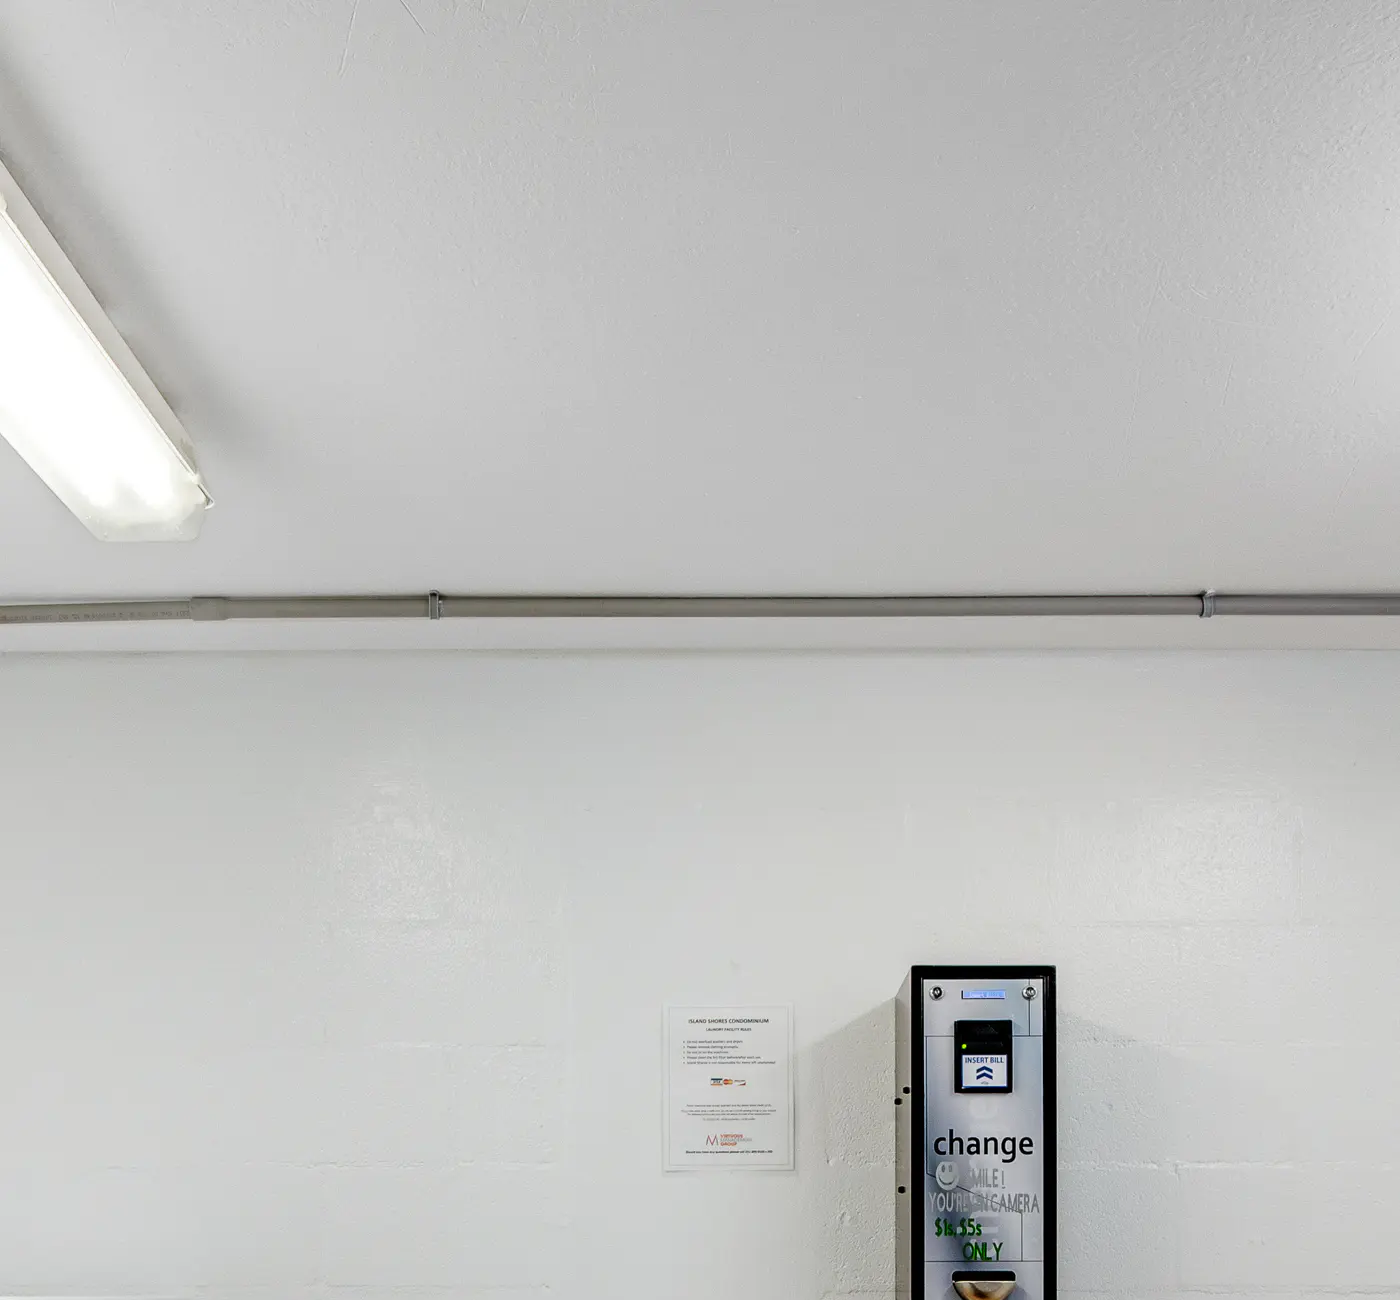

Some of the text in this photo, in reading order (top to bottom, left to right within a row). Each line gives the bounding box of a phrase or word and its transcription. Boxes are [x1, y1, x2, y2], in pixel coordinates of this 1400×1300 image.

[934, 1128, 1034, 1163] change
[991, 1193, 1040, 1213] CAMERA
[960, 1218, 982, 1237] $5s
[963, 1242, 1003, 1261] ONLY
